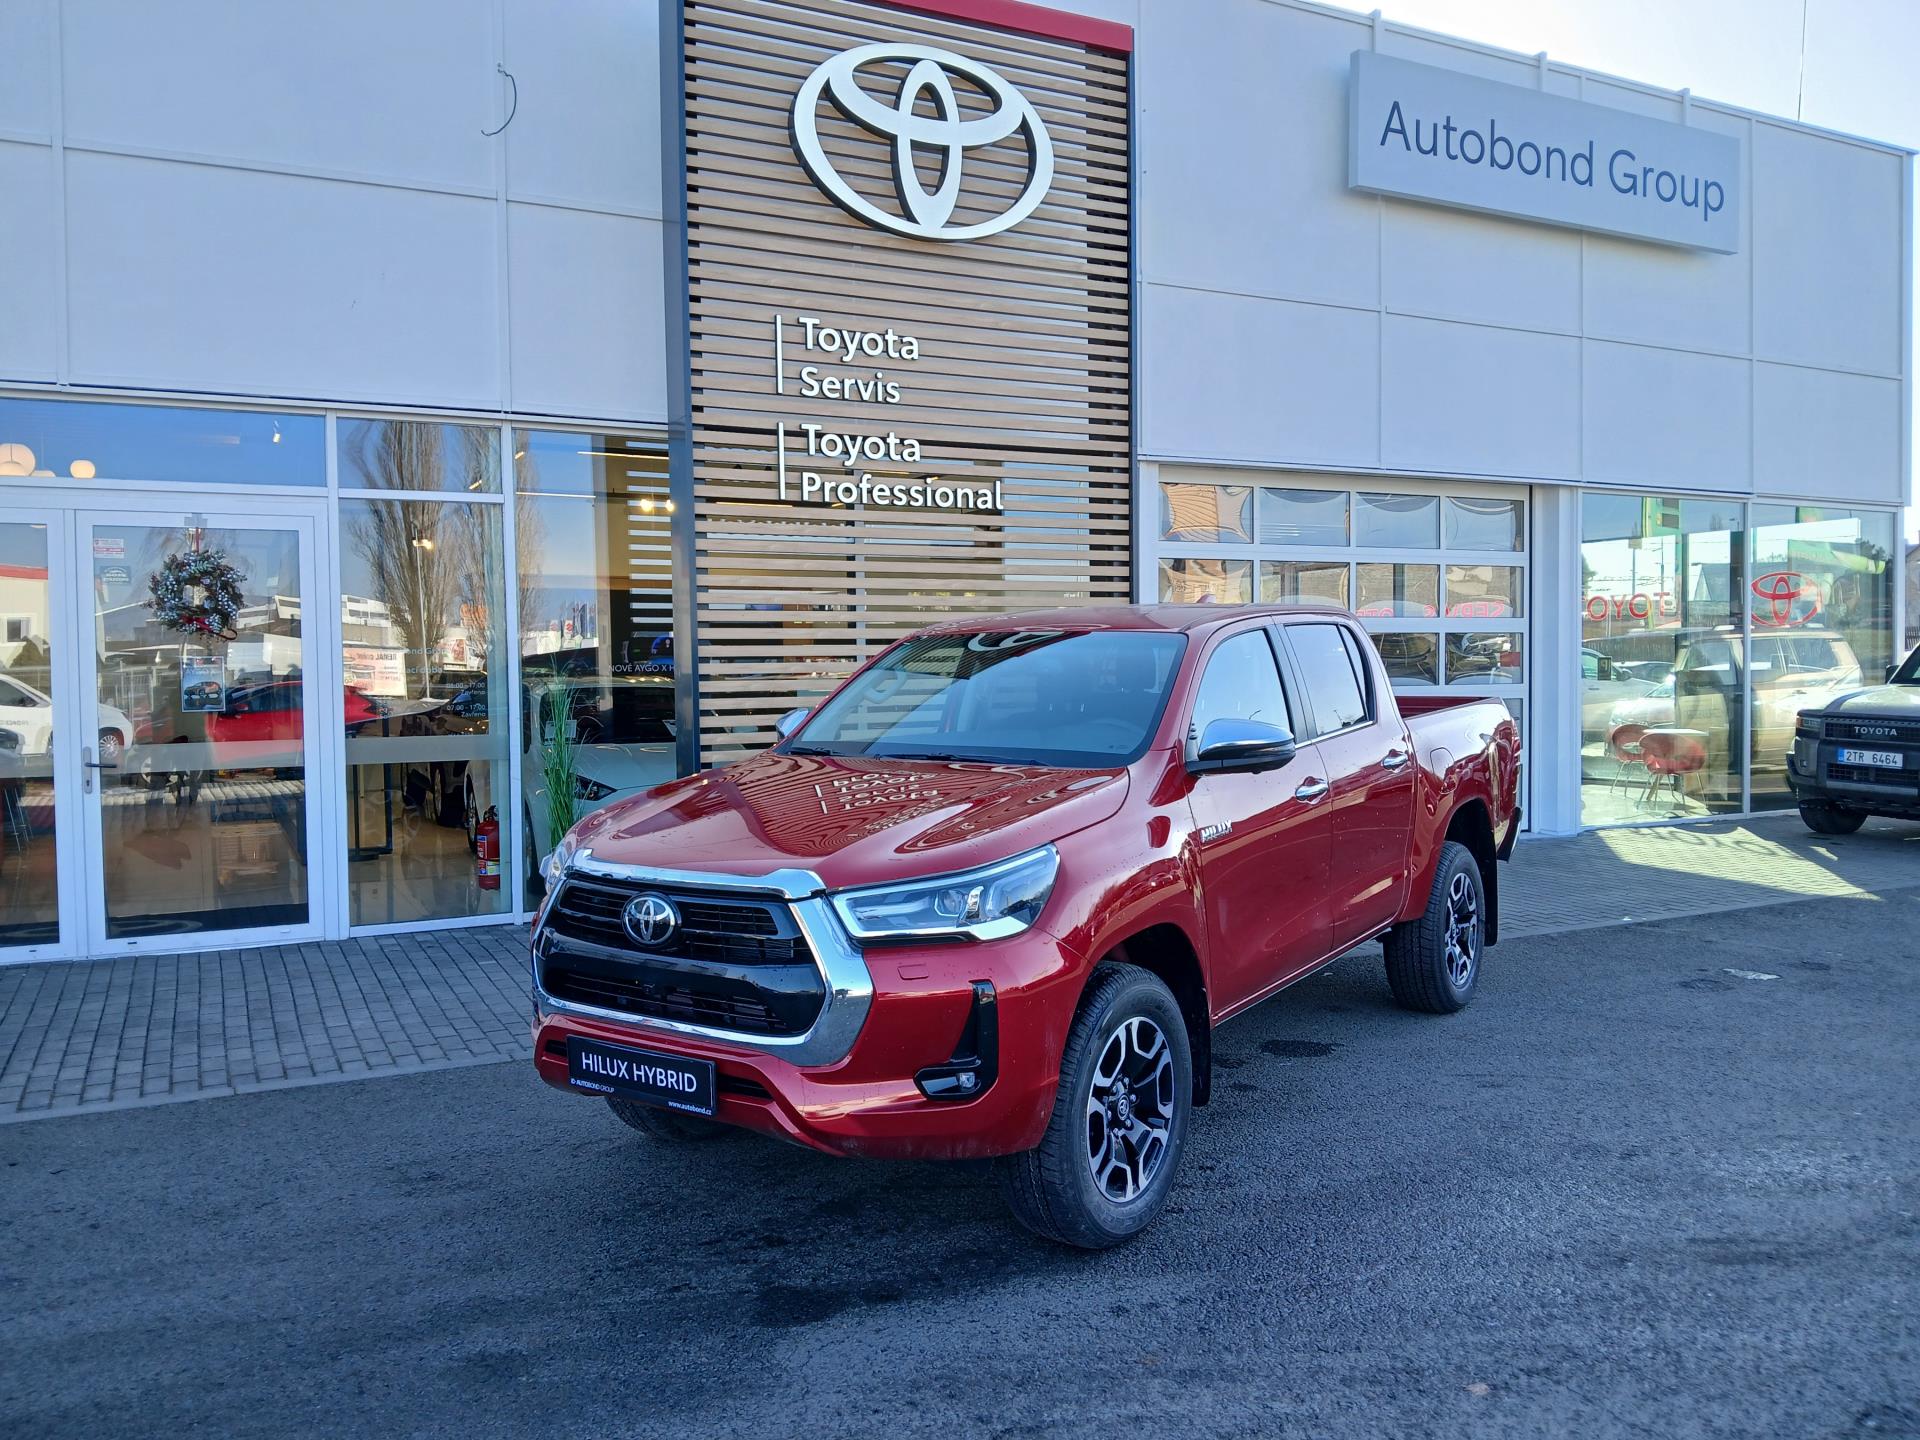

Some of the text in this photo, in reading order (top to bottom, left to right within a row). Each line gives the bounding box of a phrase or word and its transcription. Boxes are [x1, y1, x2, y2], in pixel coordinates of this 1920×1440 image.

[1380, 100, 1725, 222] Autobond Group
[798, 316, 919, 362] Toyota
[800, 366, 901, 403] Servis
[800, 423, 921, 466] Toyota
[801, 471, 1004, 510] Professional
[608, 663, 633, 672] NOVÉ
[1854, 726, 1898, 736] TOYOTA
[1846, 751, 1898, 765] 2TR 6464
[582, 1051, 697, 1092] HILUX HYBRID
[668, 1101, 712, 1115] www.autobond.cz
